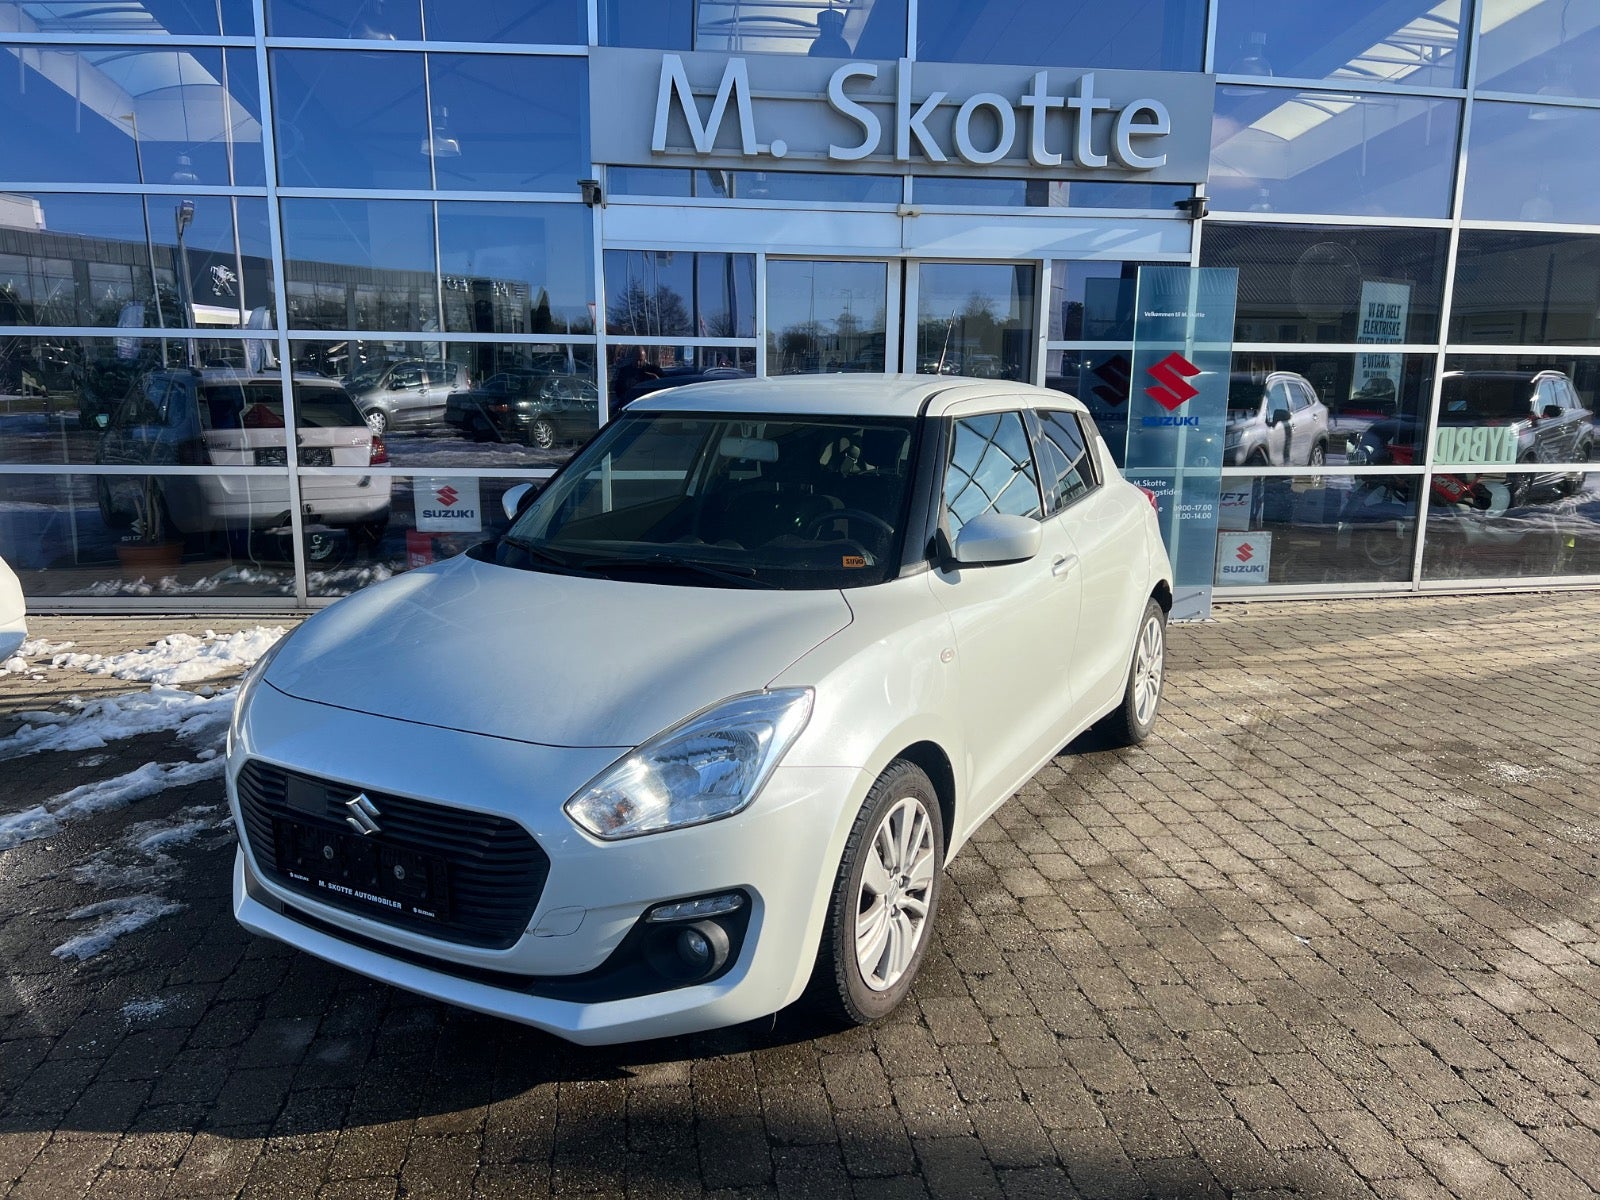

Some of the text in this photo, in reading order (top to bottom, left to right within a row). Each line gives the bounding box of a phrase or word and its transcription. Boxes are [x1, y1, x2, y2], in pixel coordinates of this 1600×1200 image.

[651, 53, 1171, 169] M. Skotte
[1376, 303, 1385, 318] ER
[1386, 303, 1401, 319] HELT
[1363, 319, 1401, 336] ELEKTRISKE
[1142, 416, 1199, 426] SUZUKI
[422, 509, 475, 518] SUZUKI
[1223, 564, 1265, 573] SUZUKI
[318, 879, 402, 909] M. SKOTTE AUTOMOBILER
